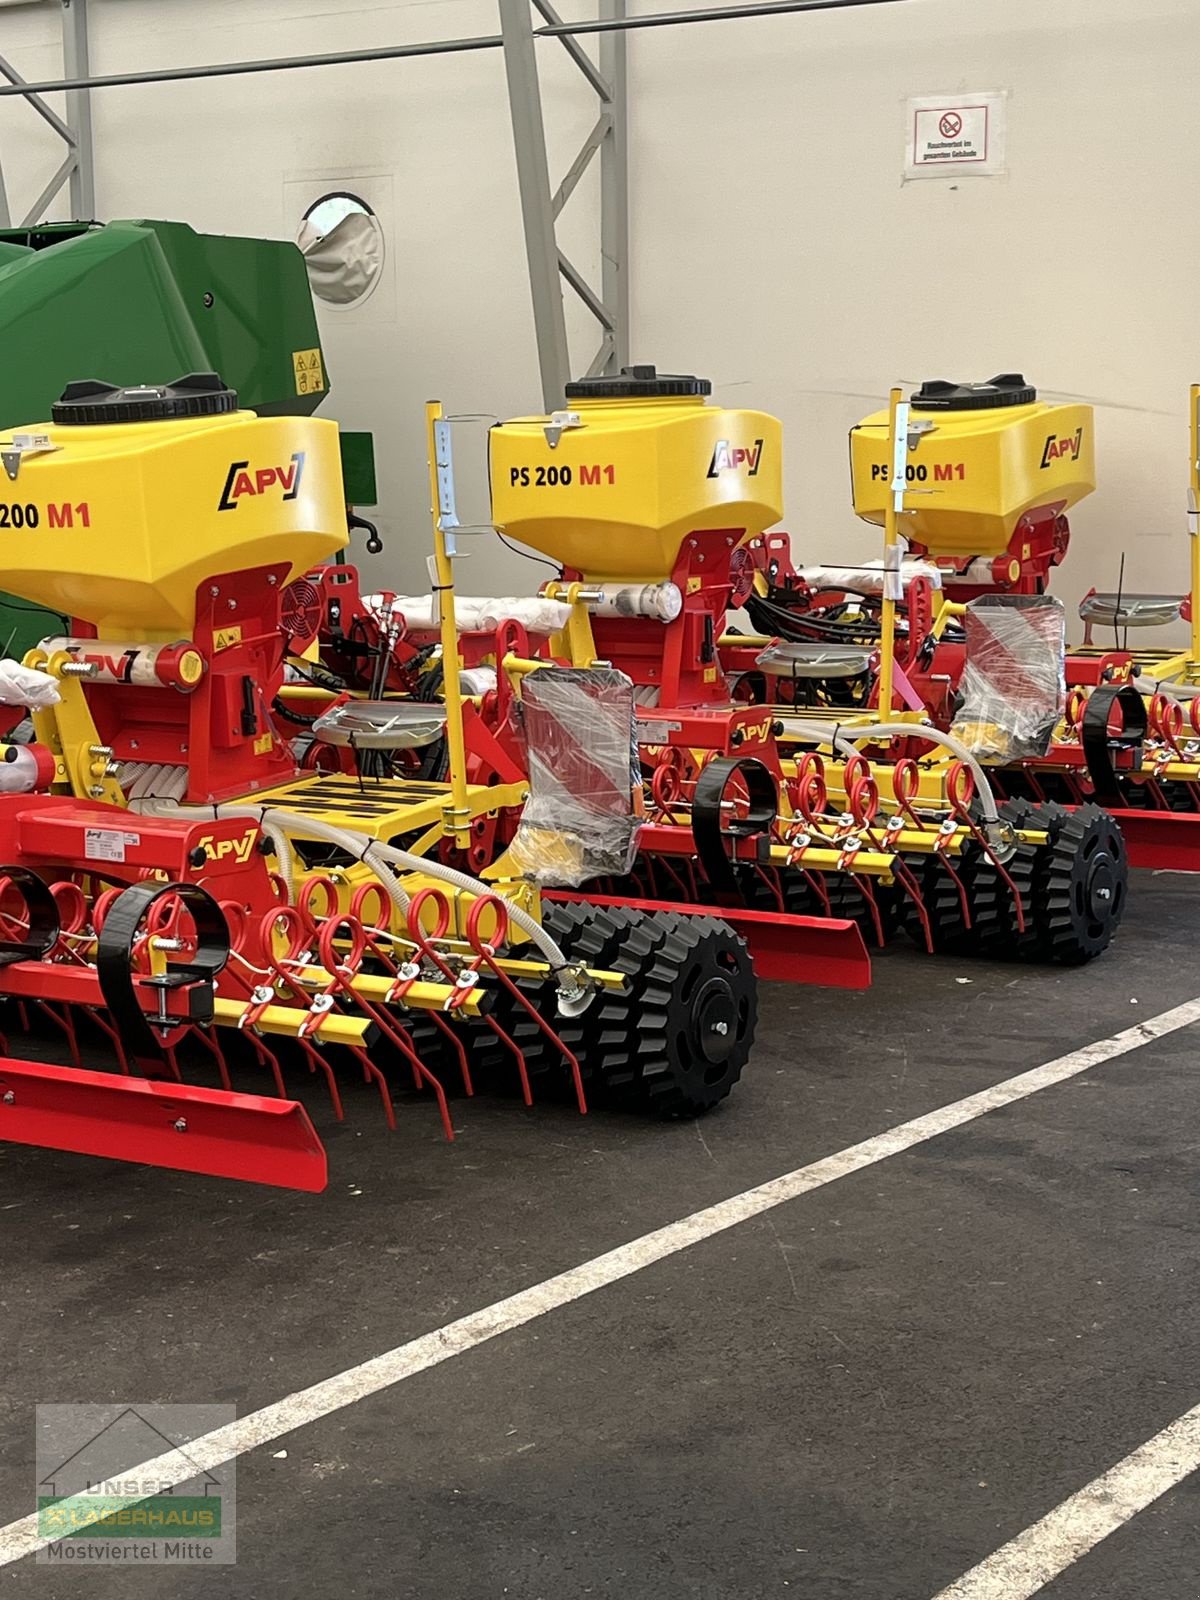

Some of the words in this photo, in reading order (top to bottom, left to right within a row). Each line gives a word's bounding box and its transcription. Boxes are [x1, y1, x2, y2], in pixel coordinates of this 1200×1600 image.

[510, 467, 529, 487] PS
[535, 466, 572, 486] 200
[579, 465, 615, 485] M1
[871, 464, 888, 481] PS
[905, 464, 928, 482] 00
[934, 463, 965, 481] M1
[0, 503, 39, 529] 200
[47, 502, 90, 528] M1
